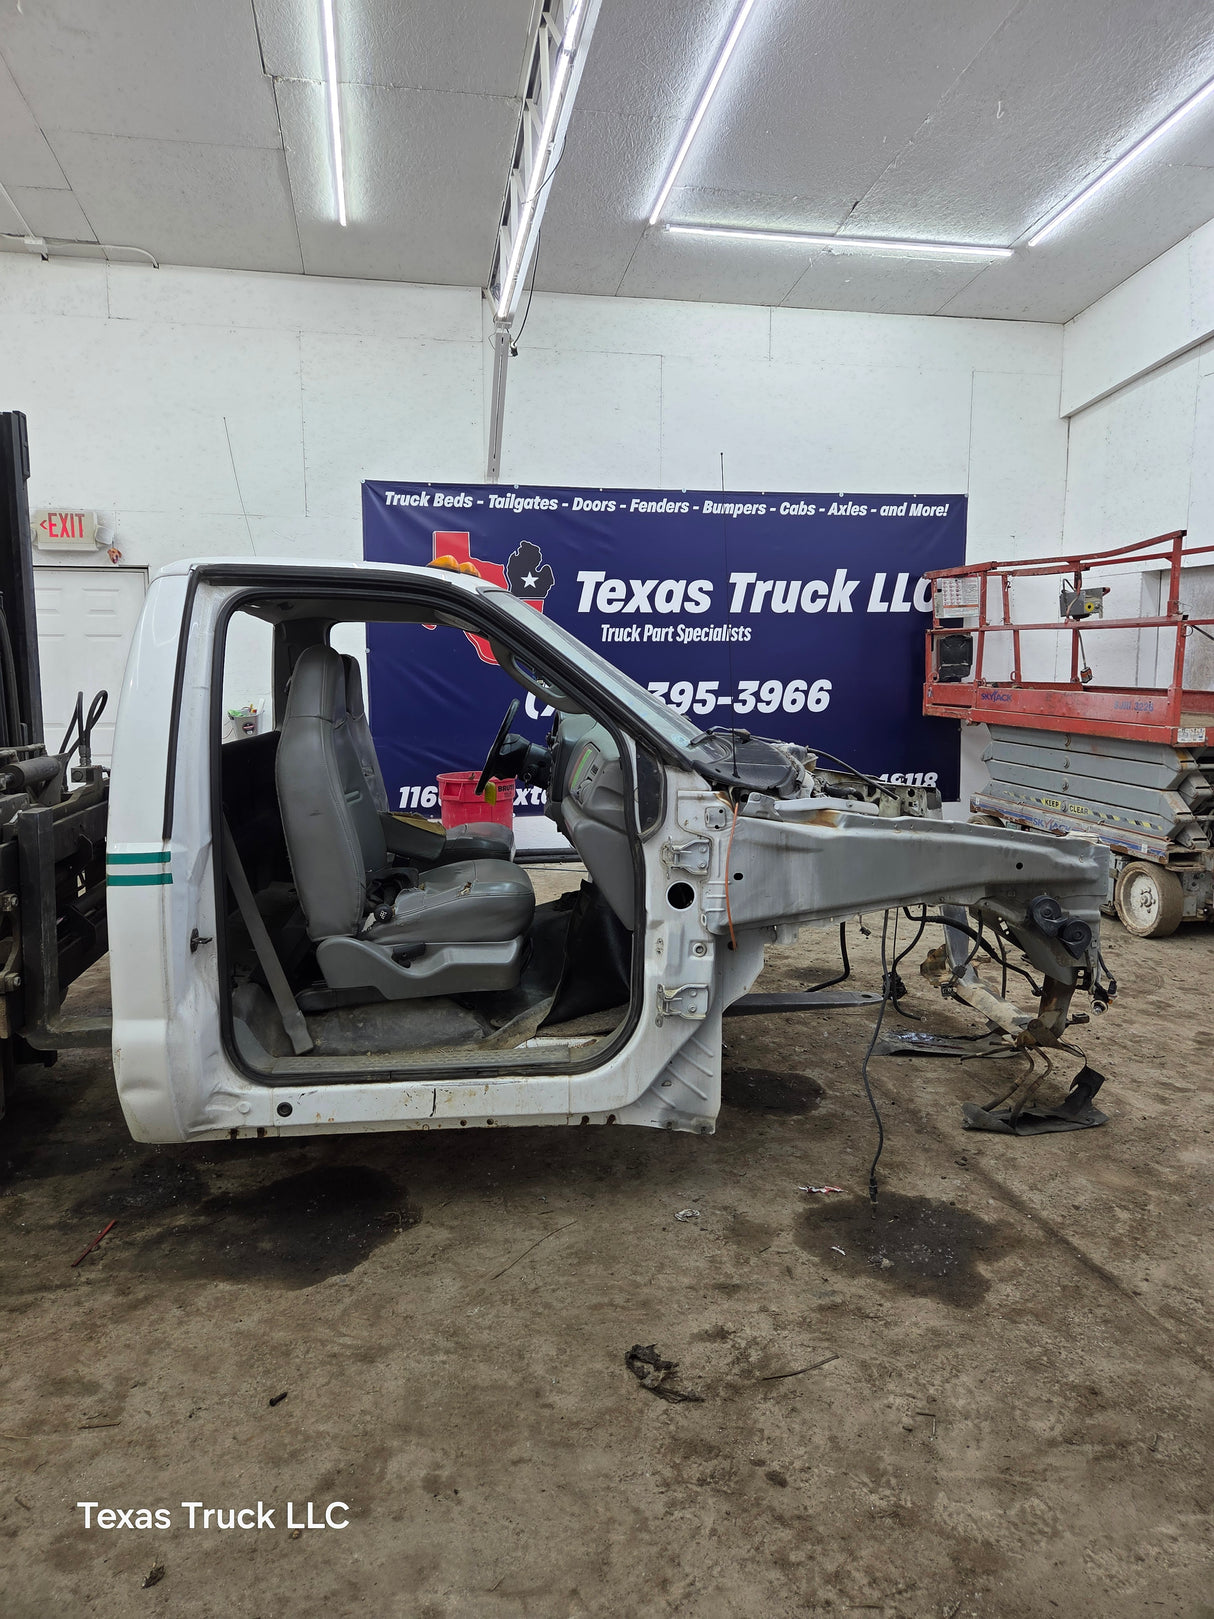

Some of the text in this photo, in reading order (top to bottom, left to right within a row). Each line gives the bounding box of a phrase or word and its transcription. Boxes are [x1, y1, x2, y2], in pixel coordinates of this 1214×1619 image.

[384, 491, 430, 507] Truck
[432, 493, 473, 508] Beds
[488, 494, 558, 513] Tailgates
[572, 497, 616, 512] Doors
[630, 498, 690, 514] Fenders
[702, 500, 767, 518] Bumpers
[779, 501, 816, 516] Cabs
[827, 502, 868, 517] Axles
[879, 503, 906, 518] and
[908, 504, 949, 517] More!
[47, 512, 85, 538] EXIT
[577, 571, 714, 614] Texas
[729, 569, 860, 614] Truck
[601, 624, 752, 644] Truck Part Specialists
